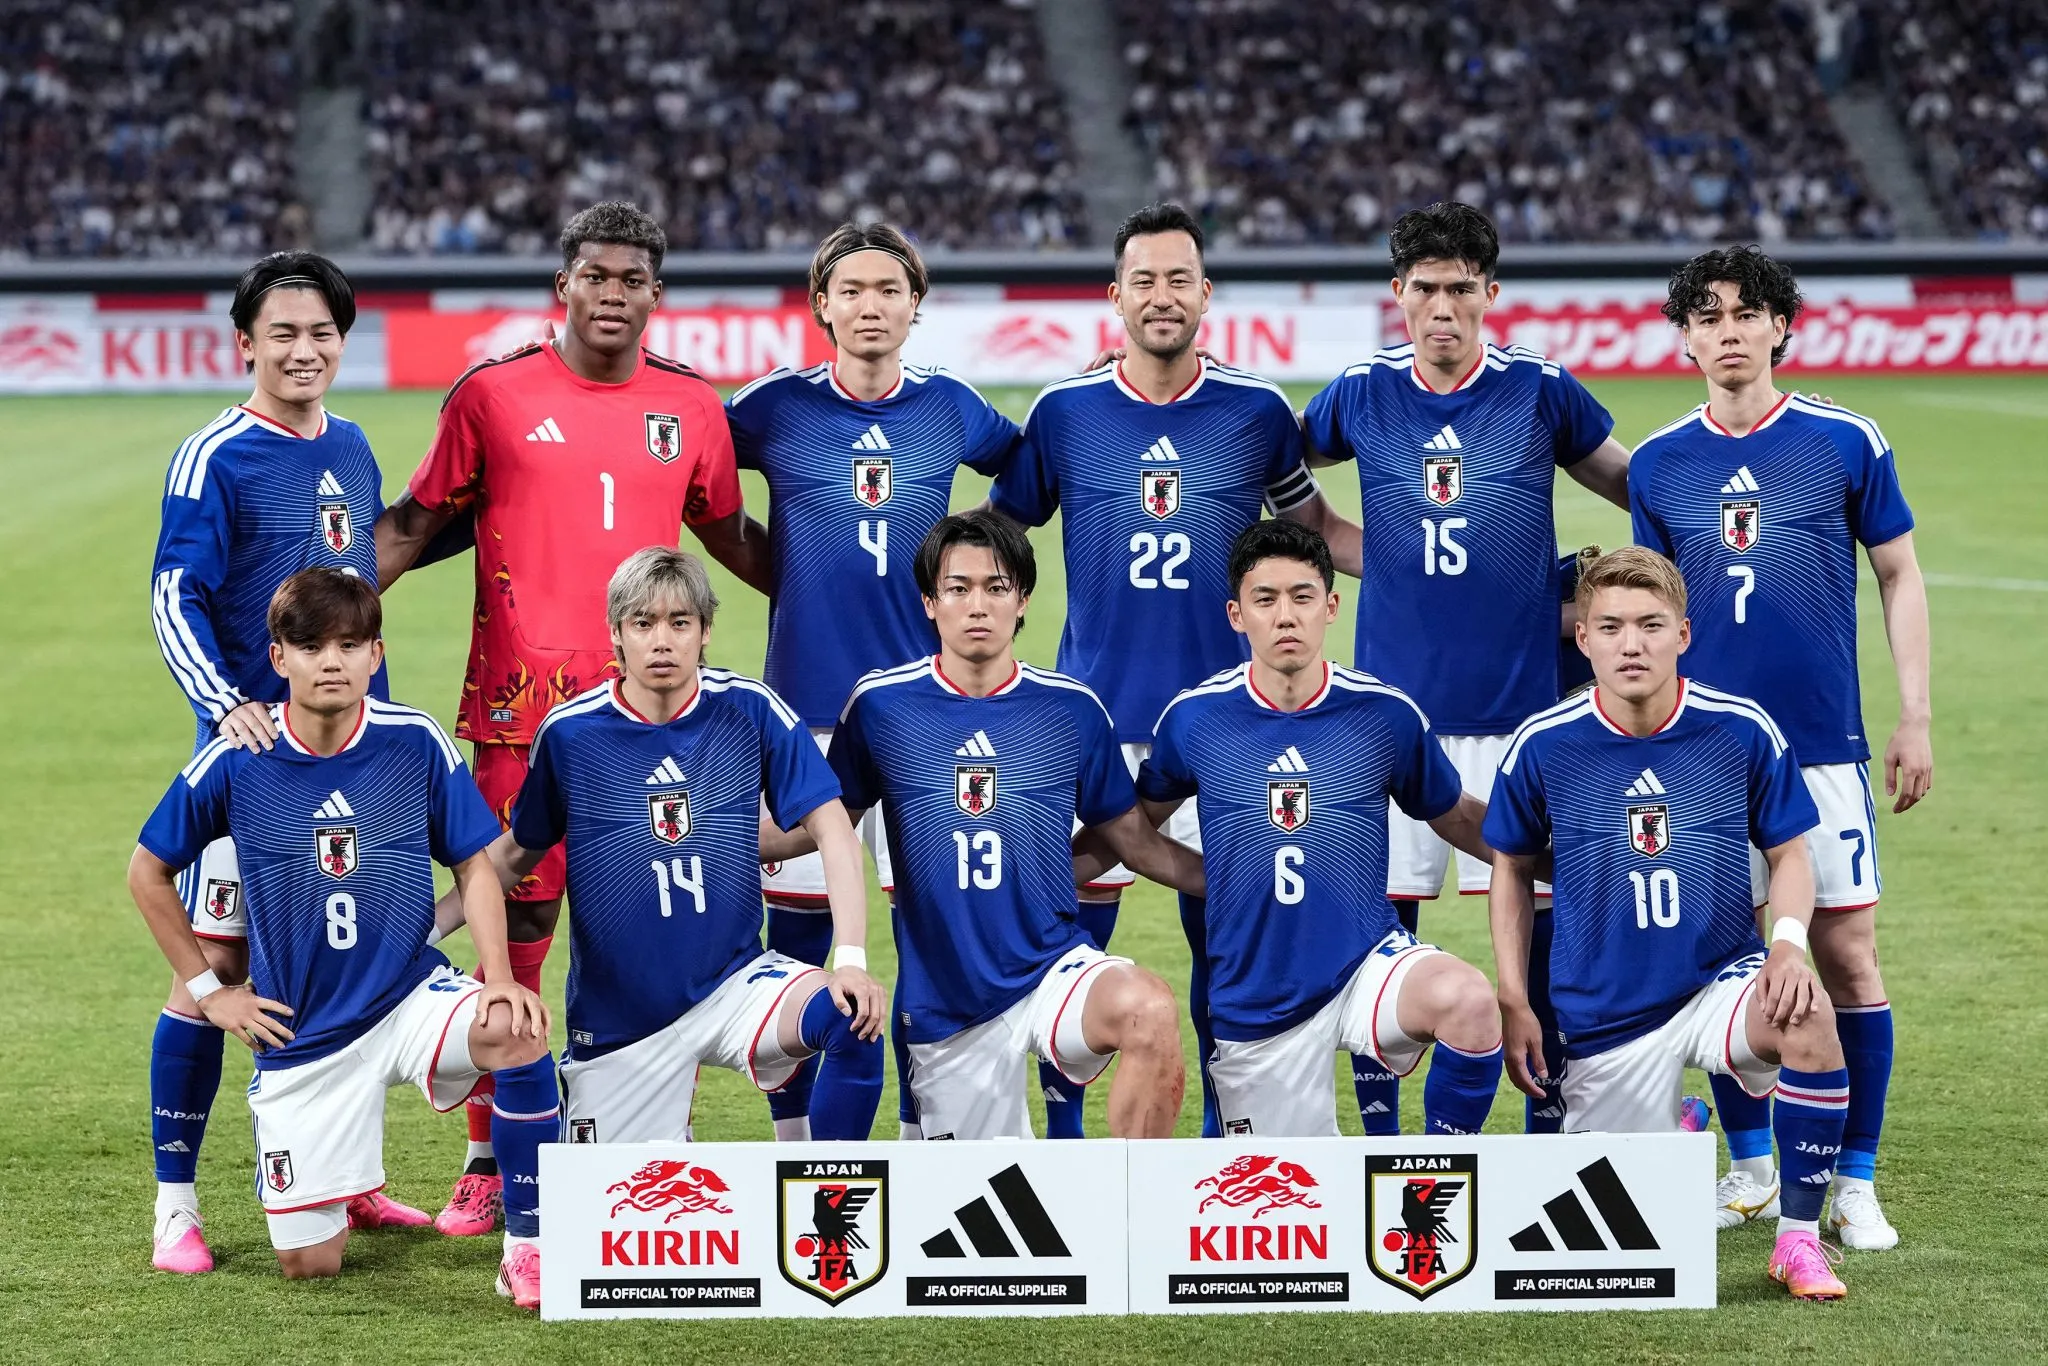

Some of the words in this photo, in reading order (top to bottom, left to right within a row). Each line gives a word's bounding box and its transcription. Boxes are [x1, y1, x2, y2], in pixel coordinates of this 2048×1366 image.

[649, 316, 804, 378] IRIN
[600, 472, 614, 530] 1
[865, 492, 882, 500] JFA
[1435, 490, 1452, 499] JFA
[1153, 503, 1169, 511] JFA
[1421, 517, 1467, 575] 15
[1732, 536, 1750, 545] JFA
[859, 520, 887, 577] 4
[1130, 532, 1190, 589] 22
[1727, 565, 1754, 624] 7
[967, 801, 985, 809] JFA
[1280, 816, 1298, 824] JFA
[664, 829, 682, 837] JFA
[1642, 842, 1660, 850] JFA
[952, 830, 1002, 890] 13
[1839, 828, 1865, 886] 7
[330, 863, 347, 871] JFA
[1275, 846, 1304, 905] 6
[651, 855, 706, 918] 14
[1628, 868, 1680, 929] 10
[325, 892, 357, 950] 8
[1354, 1072, 1395, 1081] APAN
[1532, 1076, 1560, 1086] APA
[154, 1106, 205, 1120] JAPAN
[802, 1164, 863, 1176] JAPAN
[1391, 1158, 1451, 1170] JAPAN
[601, 1230, 739, 1266] KIRIN
[1189, 1225, 1327, 1261] KIRIN
[807, 1259, 859, 1281] JFA
[1395, 1253, 1447, 1275] JFA
[924, 1285, 948, 1297] JFA
[949, 1285, 1006, 1297] OFFICIAL
[1008, 1284, 1067, 1296] SUPPLIER
[1175, 1283, 1198, 1295] JFA
[1199, 1283, 1256, 1294] OFFICIAL
[1258, 1282, 1284, 1294] TOP
[1286, 1281, 1343, 1293] PARTNER
[1512, 1279, 1536, 1291] JFA
[1538, 1278, 1594, 1290] OFFICIAL
[1596, 1277, 1656, 1289] SUPPLIER
[587, 1288, 610, 1300] JFA
[611, 1287, 669, 1299] OFFICIAL
[670, 1287, 696, 1299] TOP
[698, 1286, 756, 1298] PARTNER
